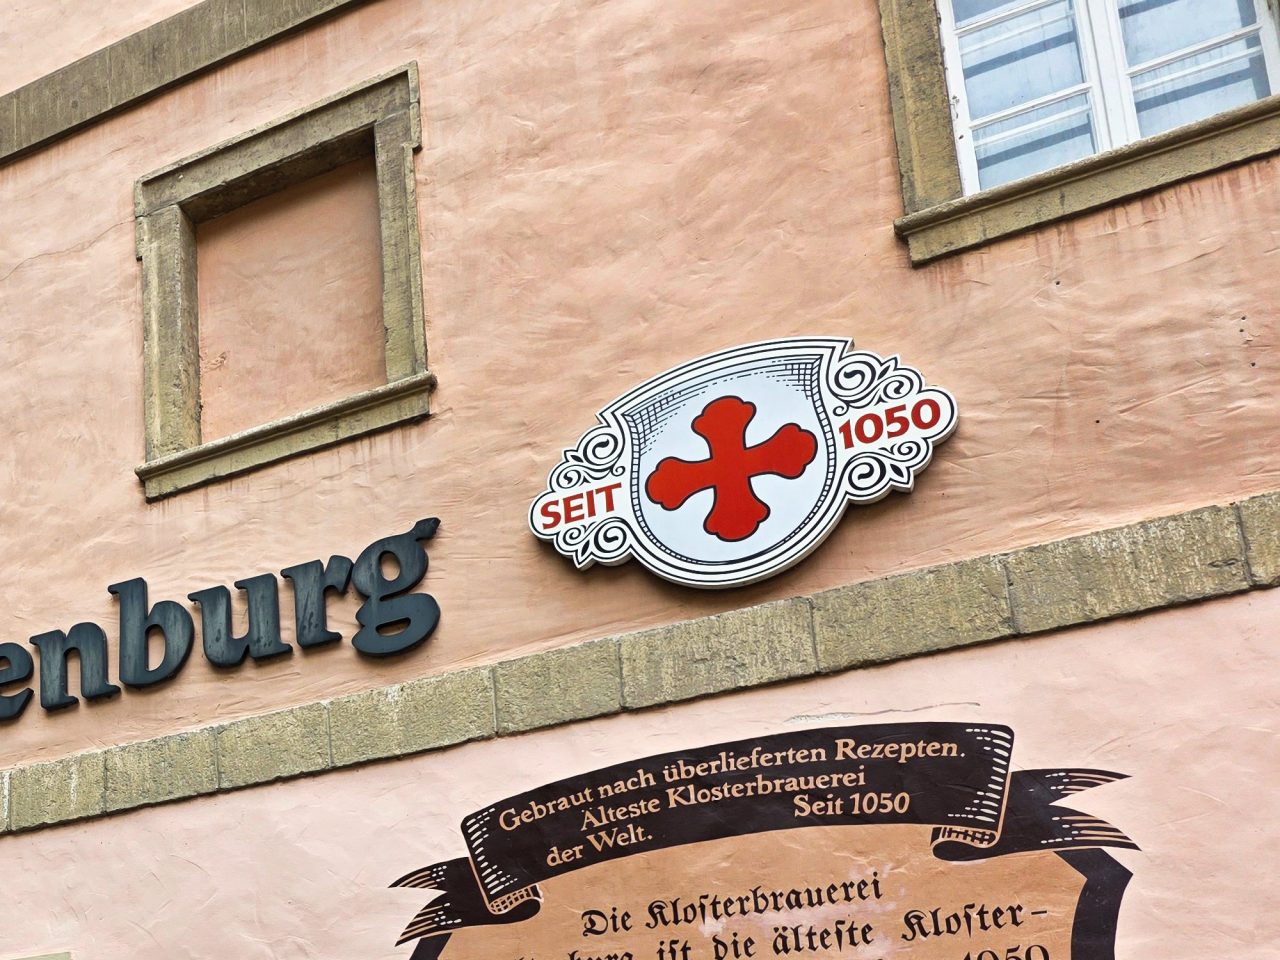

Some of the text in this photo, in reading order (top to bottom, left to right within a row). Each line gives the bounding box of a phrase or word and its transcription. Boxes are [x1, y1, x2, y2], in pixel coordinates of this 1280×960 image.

[539, 398, 942, 531] SEIT 1050
[498, 738, 965, 833] Gebraut nach überlieferten Rezepten.
[580, 766, 867, 833] Älteste Klosterbrauerei
[545, 791, 911, 869] der Welt. Seit 1050
[581, 906, 633, 937] Die
